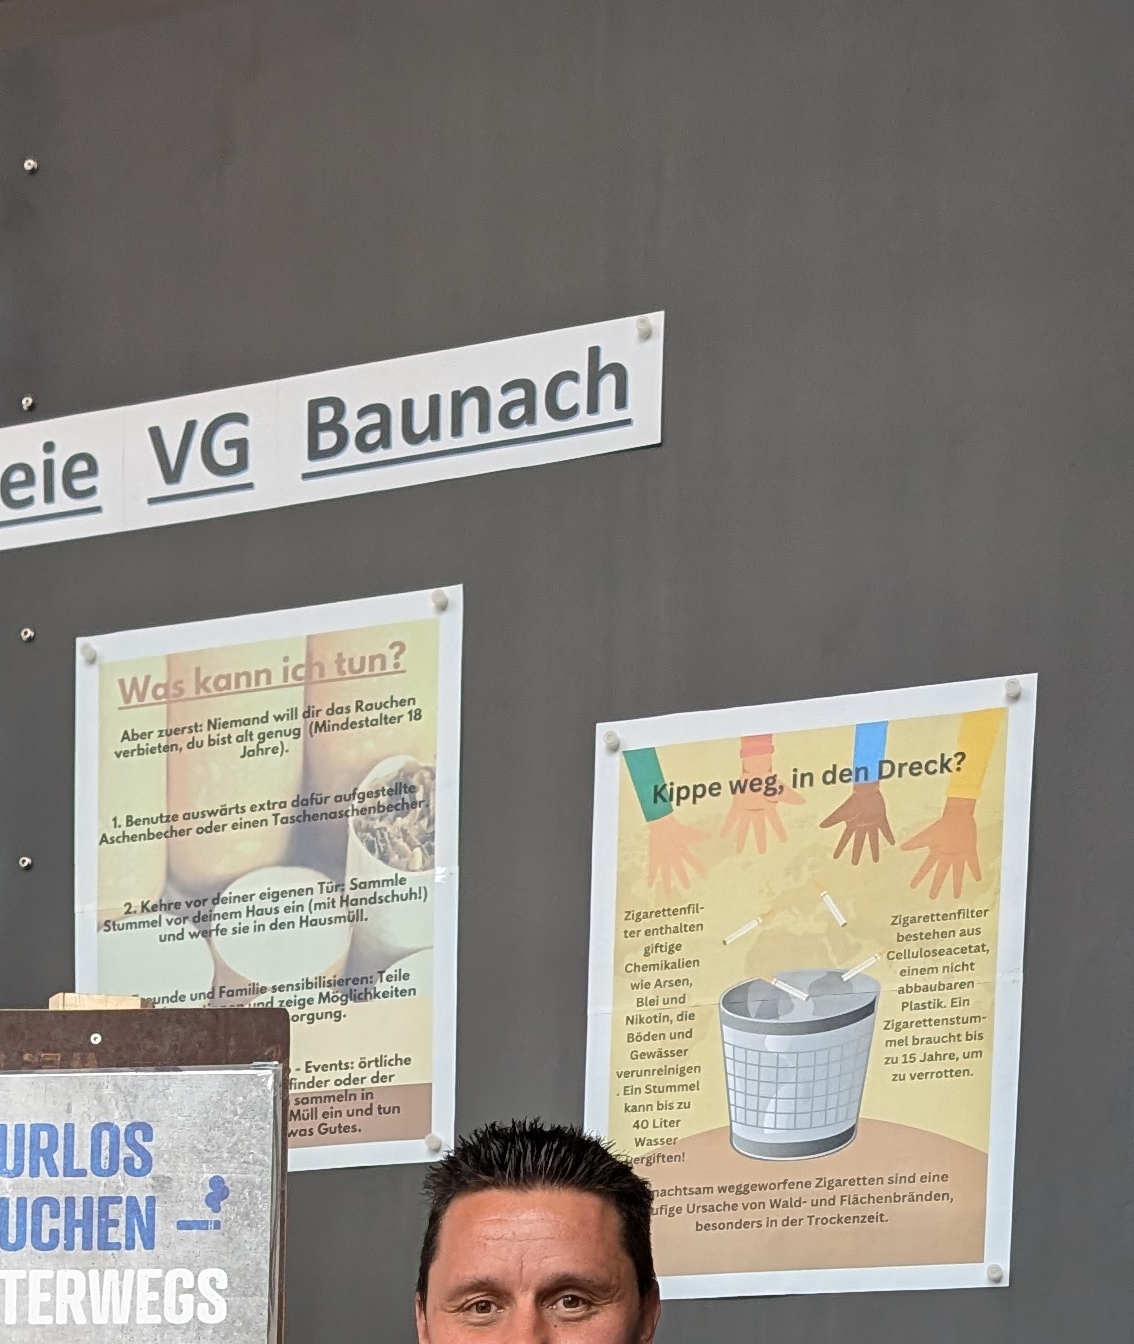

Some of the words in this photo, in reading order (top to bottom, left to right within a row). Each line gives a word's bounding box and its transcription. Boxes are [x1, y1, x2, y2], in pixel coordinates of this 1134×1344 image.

[148, 411, 249, 485] VG
[306, 345, 629, 461] Baunach
[118, 675, 185, 704] Was
[194, 665, 271, 694] kann
[283, 656, 325, 683] ich
[335, 641, 407, 676] tun?
[120, 727, 154, 743] Aber
[156, 720, 203, 741] zuerst:
[207, 710, 269, 731] Niemand
[272, 706, 298, 722] will
[302, 704, 322, 720] dir
[325, 702, 351, 716] das
[354, 696, 416, 713] Rauchen
[113, 737, 183, 759] verbieten,
[186, 735, 204, 750] du
[207, 732, 232, 747] bist
[235, 728, 254, 743] alt
[256, 727, 301, 745] genug
[308, 712, 404, 737] (Mindestalter
[406, 708, 422, 722] 18
[239, 740, 289, 759] Jahre).
[653, 781, 722, 805] Kippe
[728, 773, 784, 795] weg,
[792, 768, 814, 789] in
[821, 765, 868, 786] den
[877, 751, 966, 780] Dreck?
[111, 815, 121, 829] 1.
[125, 810, 179, 827] Benutze
[182, 803, 246, 821] auswärts
[249, 799, 287, 813] extra
[290, 792, 330, 808] dafür
[333, 782, 418, 804] aufgestellte
[97, 824, 193, 846] Aschenbecher
[195, 819, 228, 835] oder
[230, 816, 268, 831] einen
[271, 795, 431, 826] Taschenaschenbecher.
[623, 903, 704, 923] Zigarettenfil-
[889, 907, 989, 927] Zigarettenfilter
[623, 929, 642, 938] ter
[644, 922, 704, 937] enthalten
[896, 928, 956, 943] bestehen
[958, 926, 981, 937] aus
[642, 941, 682, 957] giftige
[886, 942, 990, 961] Celluloseacetat,
[624, 957, 700, 974] Chemikalien
[899, 965, 938, 977] einem
[941, 960, 975, 976] nicht
[630, 978, 651, 990] wie
[653, 977, 693, 989] Arsen,
[898, 980, 974, 994] abbaubaren
[635, 994, 659, 1008] Blei
[662, 992, 686, 1005] und
[901, 997, 947, 1012] Plastik.
[950, 996, 970, 1008] Ein
[625, 1012, 673, 1026] Nikotin,
[676, 1010, 695, 1022] die
[882, 1014, 987, 1032] Zigarettenstum-
[884, 1035, 909, 1048] mel
[911, 1031, 963, 1046] braucht
[965, 1029, 984, 1041] bis
[883, 1055, 899, 1065] zu
[901, 1052, 916, 1064] 15
[918, 1050, 959, 1063] Jahre,
[962, 1049, 983, 1059] um
[891, 1072, 906, 1082] zu
[908, 1068, 973, 1081] verrotten.
